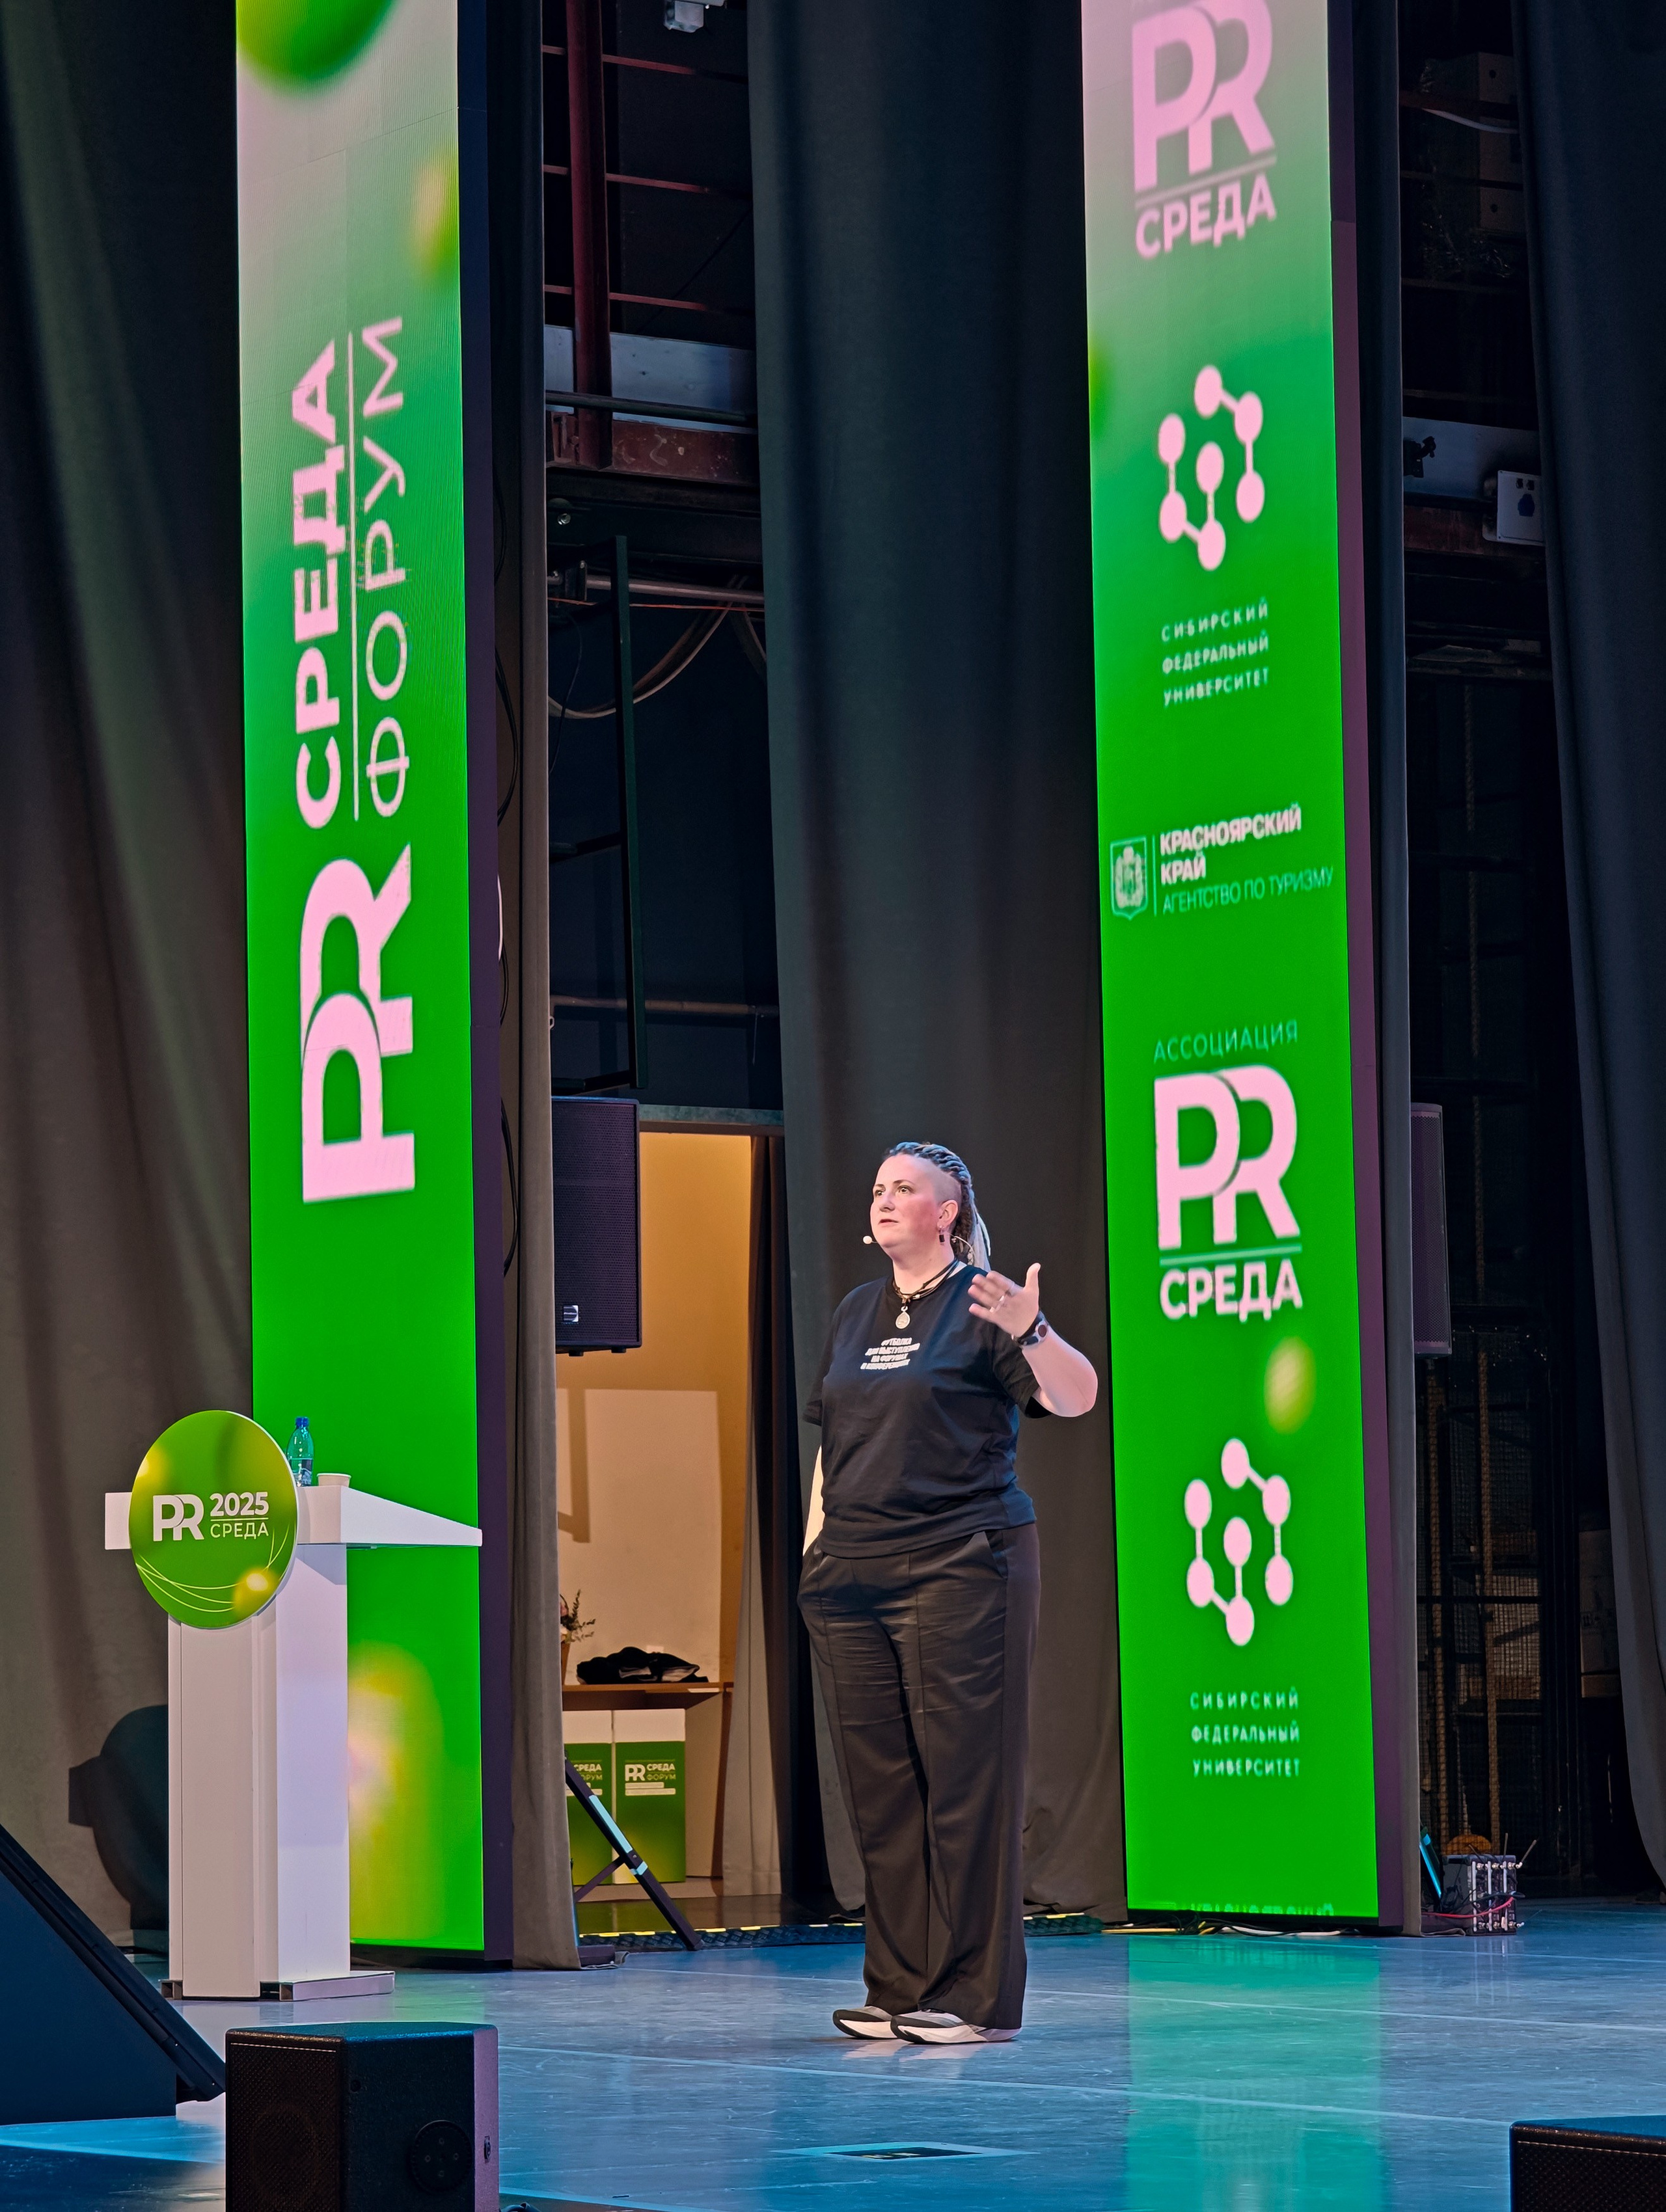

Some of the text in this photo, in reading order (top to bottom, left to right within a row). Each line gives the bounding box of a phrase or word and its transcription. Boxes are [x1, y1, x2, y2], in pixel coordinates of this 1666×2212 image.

[1132, 0, 1275, 193] PR
[1136, 172, 1276, 259] СРЕДА
[292, 340, 346, 829] СРЕДА
[361, 316, 409, 818] ФОРУМ
[1162, 597, 1268, 642] СИБИРСКИЙ
[1162, 630, 1269, 674] ФЕДЕРАЛЬНЫЙ
[1164, 667, 1269, 708] УНИВЕРСИТЕТ
[1160, 802, 1302, 856] КРАСНОЯРСКИЙ
[1161, 850, 1207, 885] КРАЙ
[1162, 866, 1333, 914] АГЕНТСТВО ПО ТУРИЗМУ
[300, 843, 415, 1202] PR
[1154, 1019, 1298, 1063] АССОЦИАЦИЯ
[1154, 1064, 1300, 1249] PR
[1160, 1258, 1302, 1322] СРЕДА
[153, 1494, 204, 1541] PR
[210, 1492, 269, 1517] 2025
[210, 1522, 269, 1539] СРЕДА
[1190, 1686, 1298, 1710] СИБИРСКИЙ
[1191, 1720, 1300, 1745] ФЕДЕРАЛЬНЫЙ
[625, 1764, 646, 1781] PR
[646, 1763, 676, 1772] СРЕДА
[1192, 1758, 1300, 1777] УНИВЕРСИТЕТ
